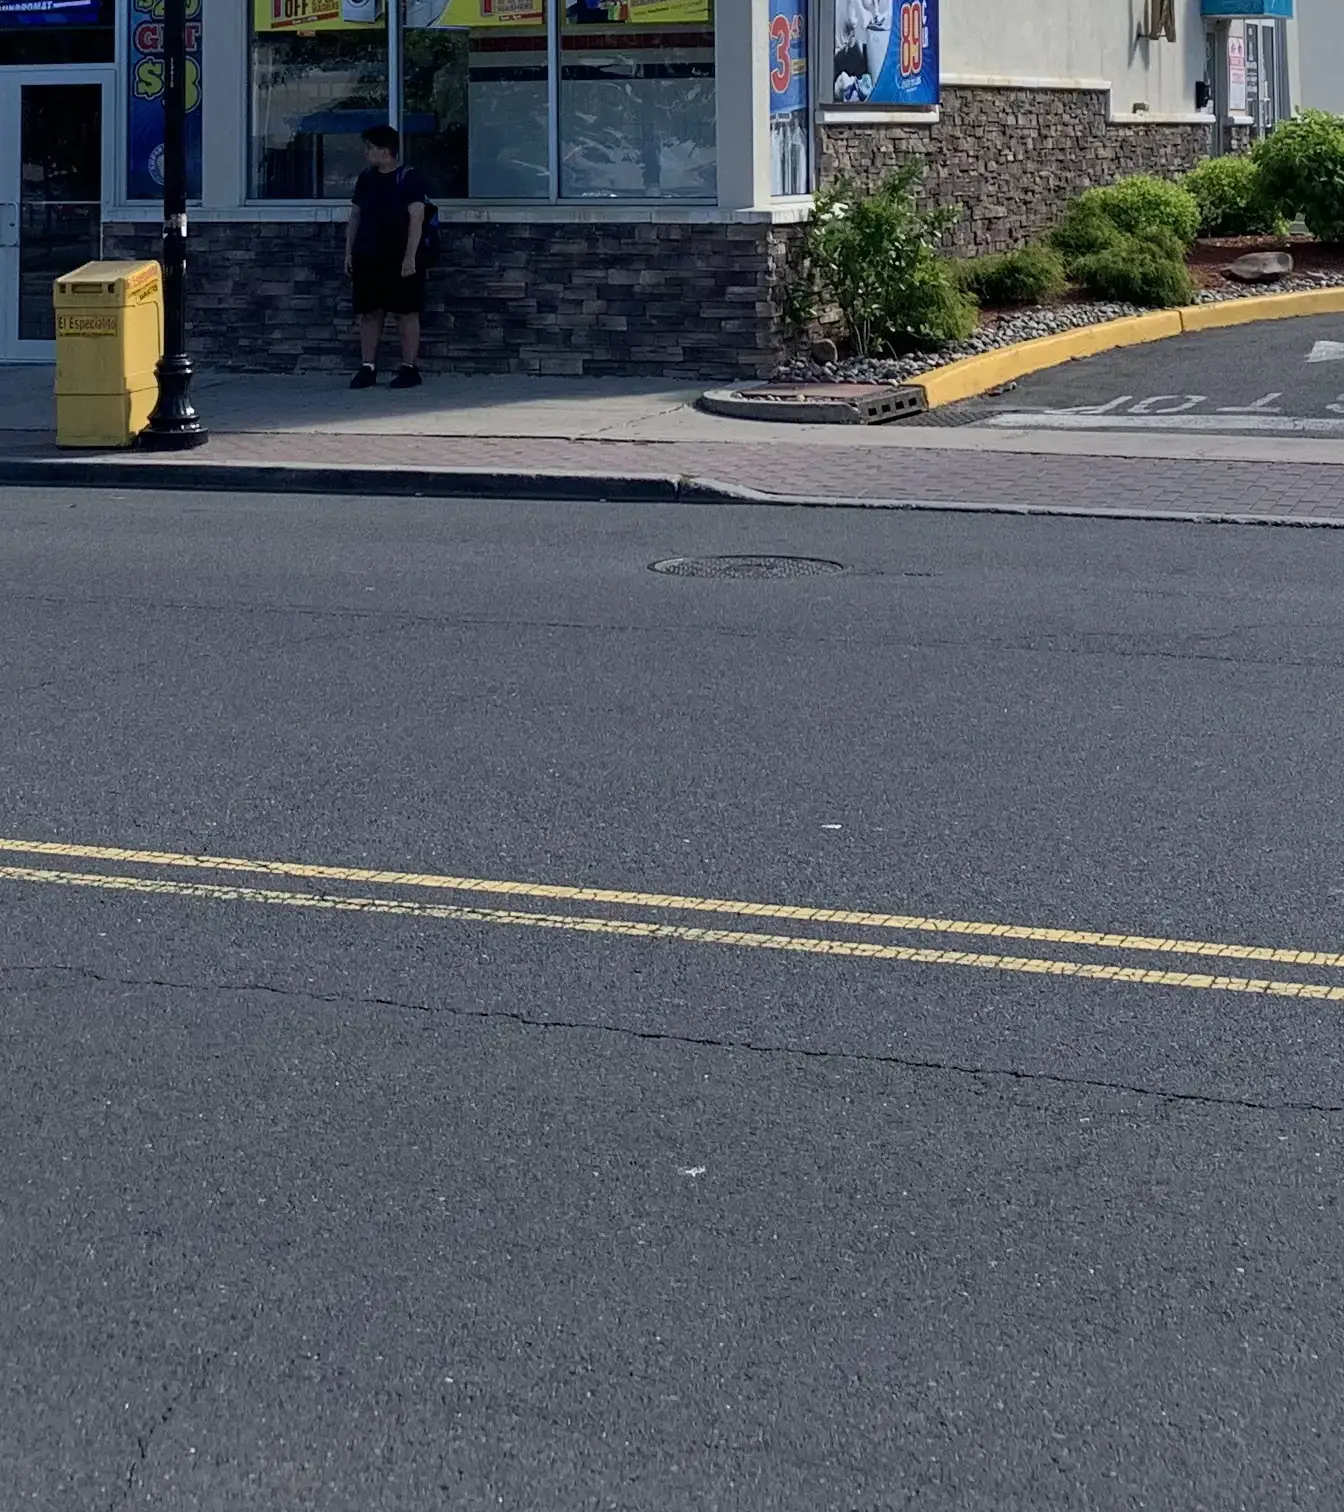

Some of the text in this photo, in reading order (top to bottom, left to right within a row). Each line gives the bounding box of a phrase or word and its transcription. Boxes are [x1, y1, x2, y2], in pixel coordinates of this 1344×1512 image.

[137, 23, 201, 52] GT
[901, 0, 922, 76] 89
[58, 316, 66, 329] El
